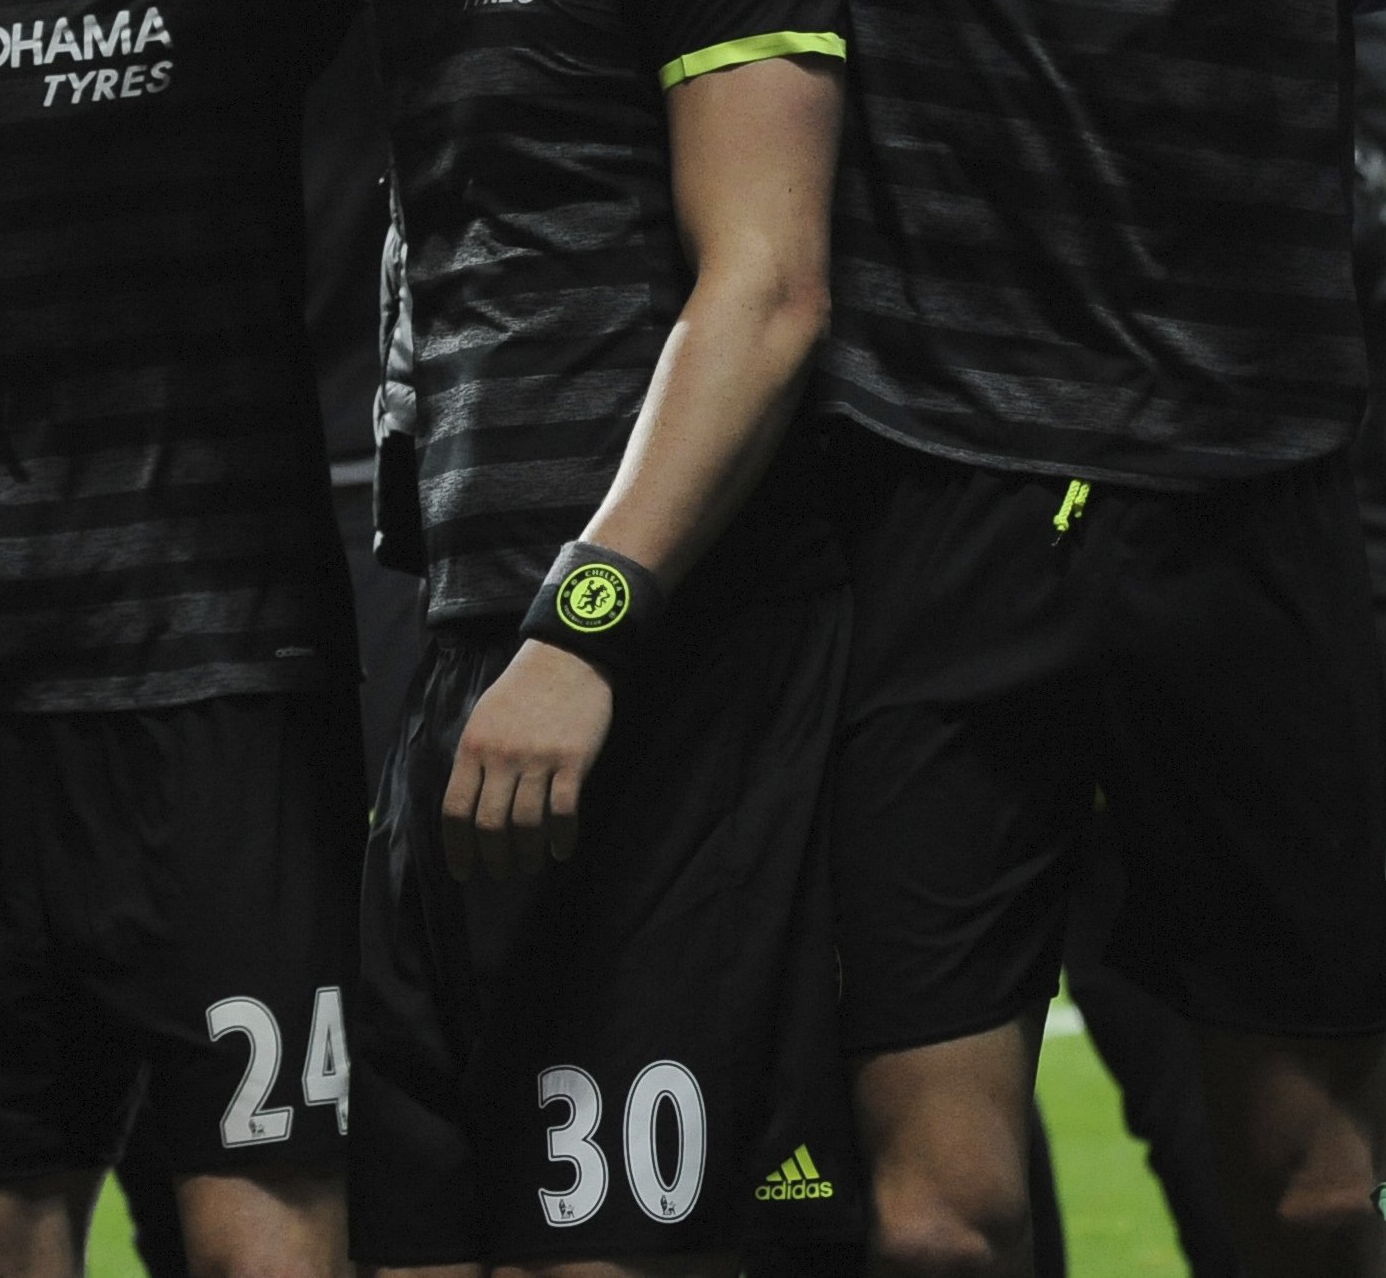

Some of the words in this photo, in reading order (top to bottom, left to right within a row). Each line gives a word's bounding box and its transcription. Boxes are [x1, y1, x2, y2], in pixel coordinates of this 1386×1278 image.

[42, 60, 174, 108] TYRES
[584, 569, 623, 593] CHELSEA
[204, 985, 352, 1150] 24
[537, 1059, 707, 1227] 30
[754, 1179, 834, 1201] adidas
